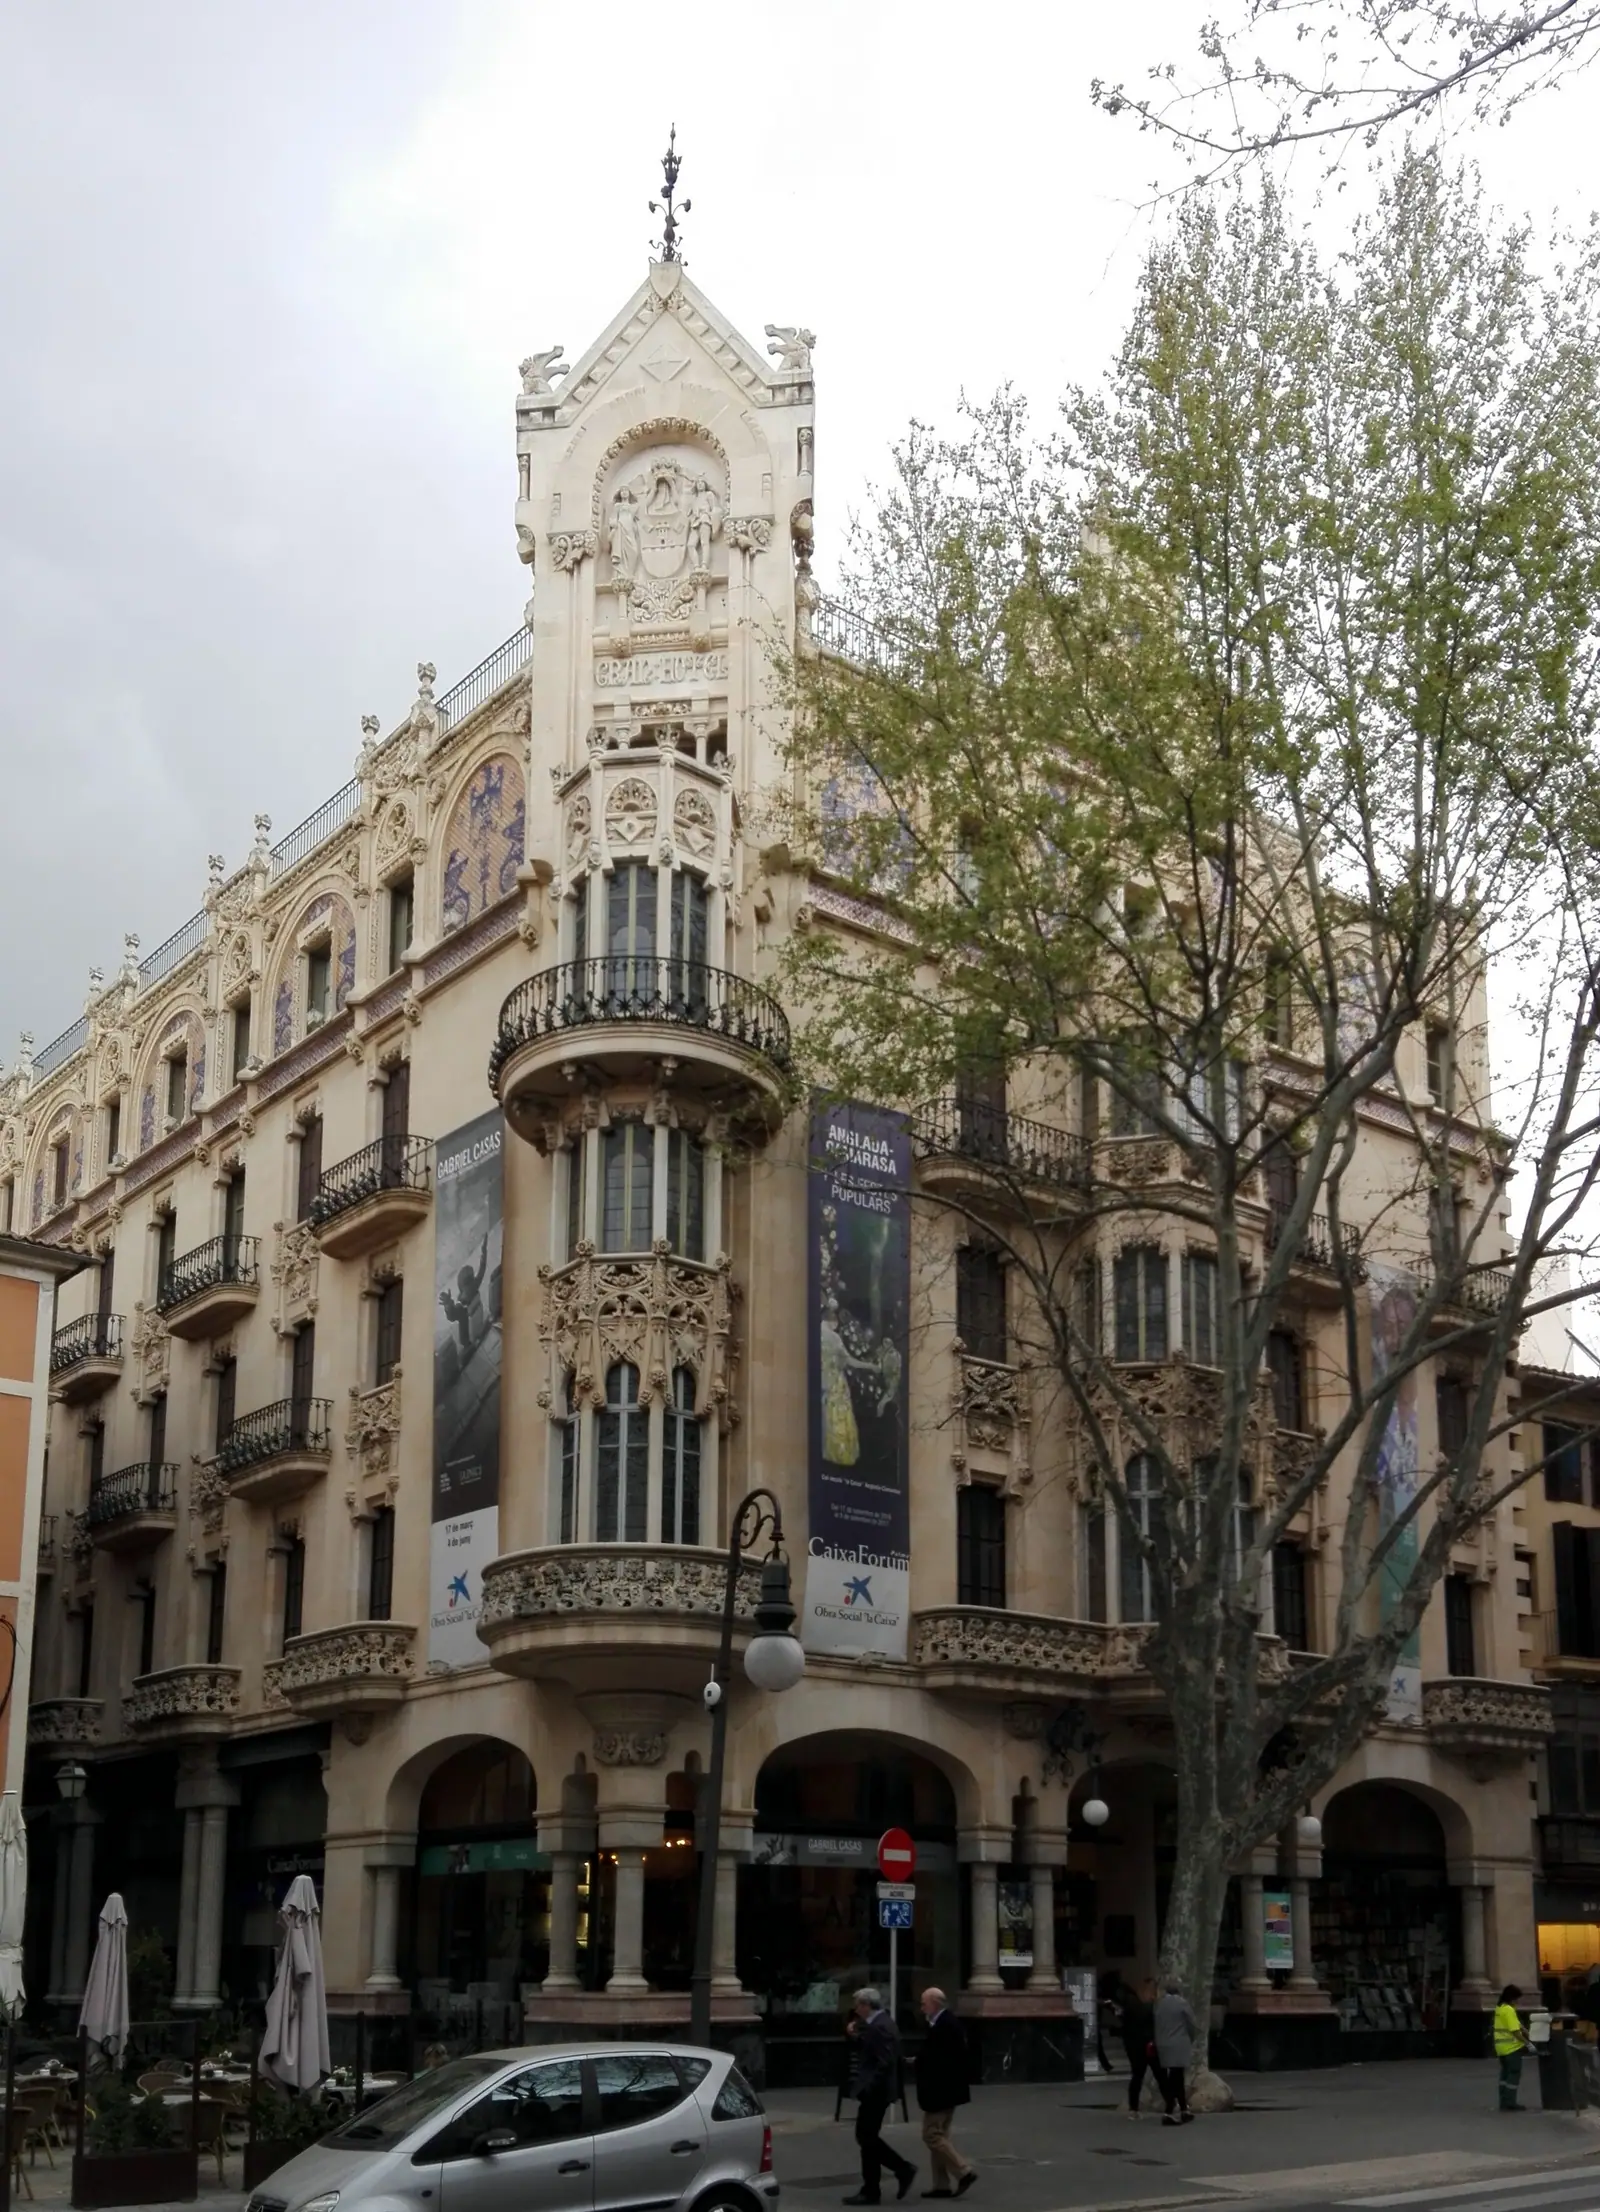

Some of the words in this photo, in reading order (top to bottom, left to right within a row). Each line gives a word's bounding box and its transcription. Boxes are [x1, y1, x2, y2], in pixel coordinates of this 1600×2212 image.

[659, 655, 728, 685] HOTEL
[437, 1147, 472, 1179] GABRIEL
[473, 1131, 501, 1160] CASAS
[831, 1184, 892, 1214] POPULARS
[808, 1536, 909, 1572] CaixaForum
[814, 1605, 836, 1619] Obra
[838, 1609, 863, 1623] Social
[808, 1838, 838, 1850] GABRIEL
[839, 1840, 862, 1851] CASAS
